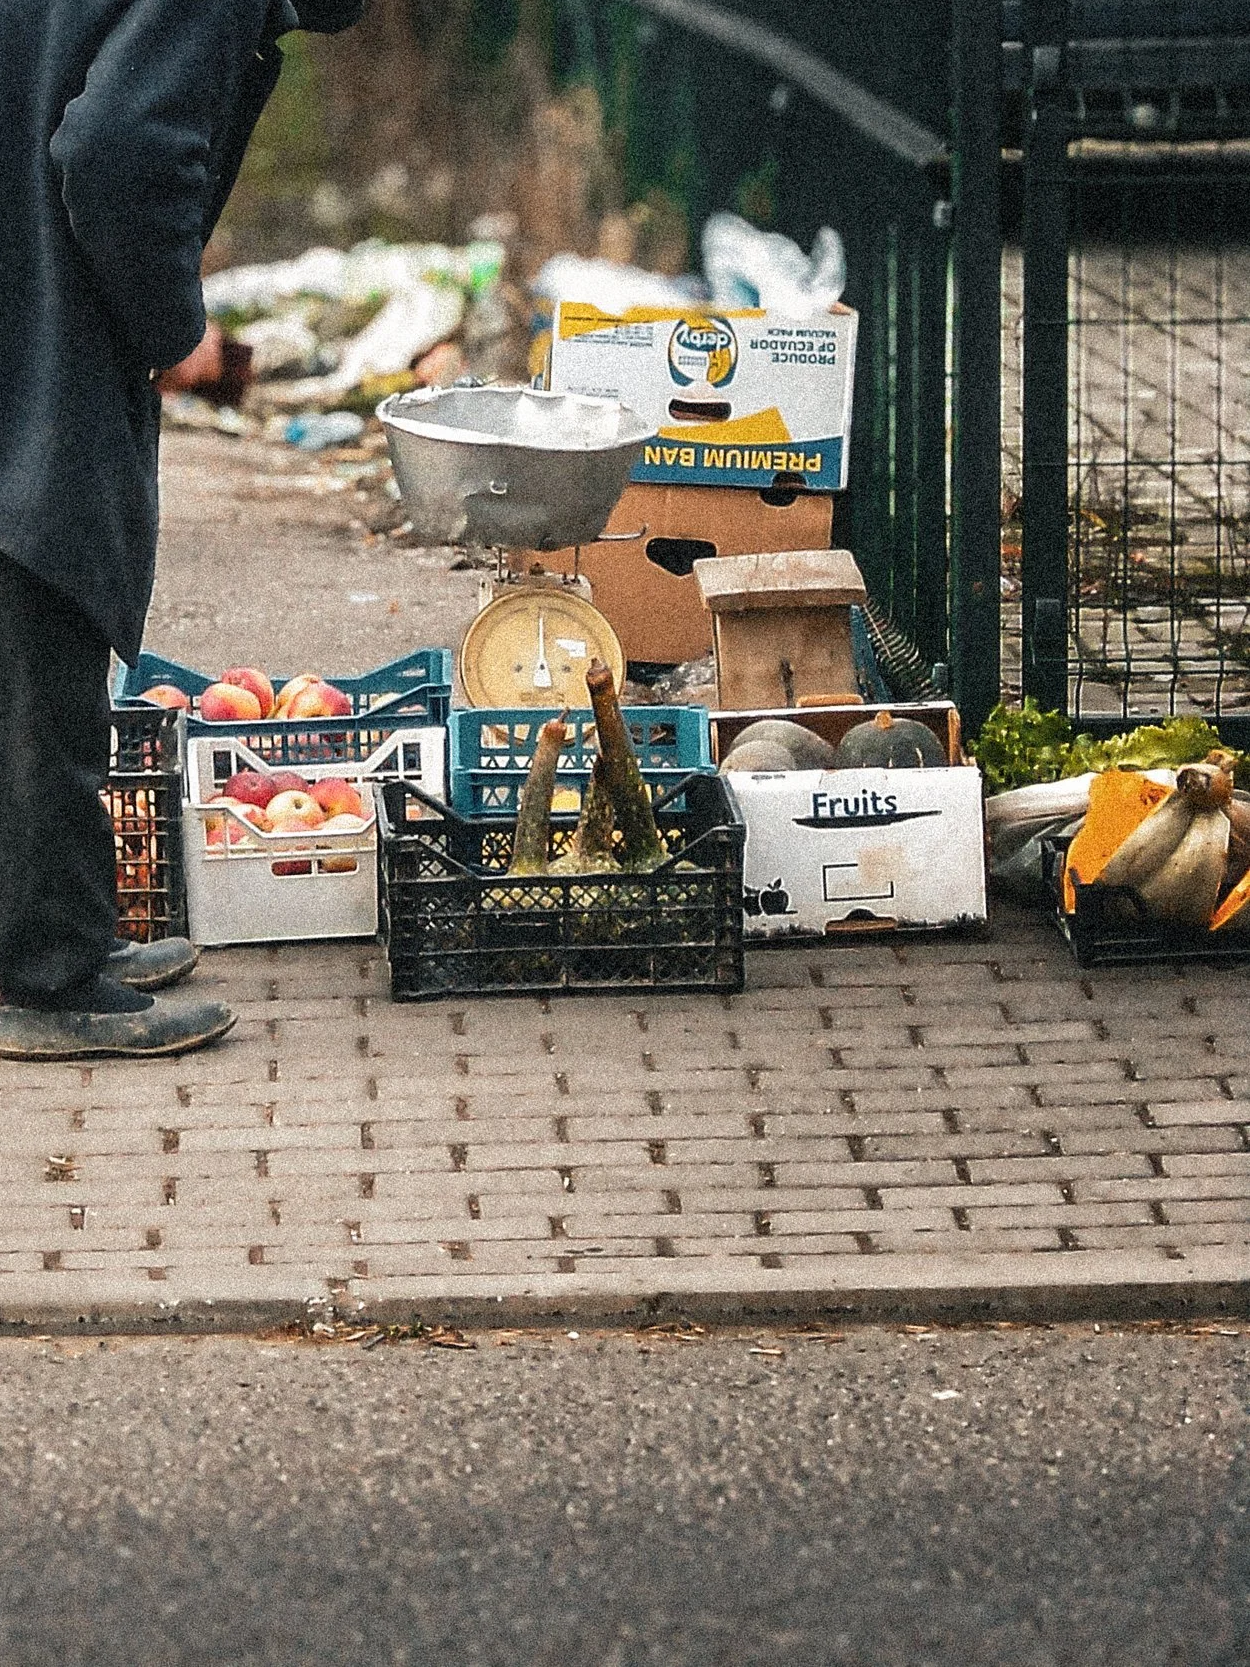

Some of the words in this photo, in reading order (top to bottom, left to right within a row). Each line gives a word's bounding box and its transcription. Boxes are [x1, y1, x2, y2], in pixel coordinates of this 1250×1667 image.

[679, 328, 730, 352] derby
[795, 329, 837, 339] VACUUM
[749, 338, 815, 352] ECUADOR
[817, 341, 837, 353] OF
[771, 352, 836, 366] PRODUCE
[703, 448, 822, 472] PREMIUM
[811, 789, 898, 818] Fruits
